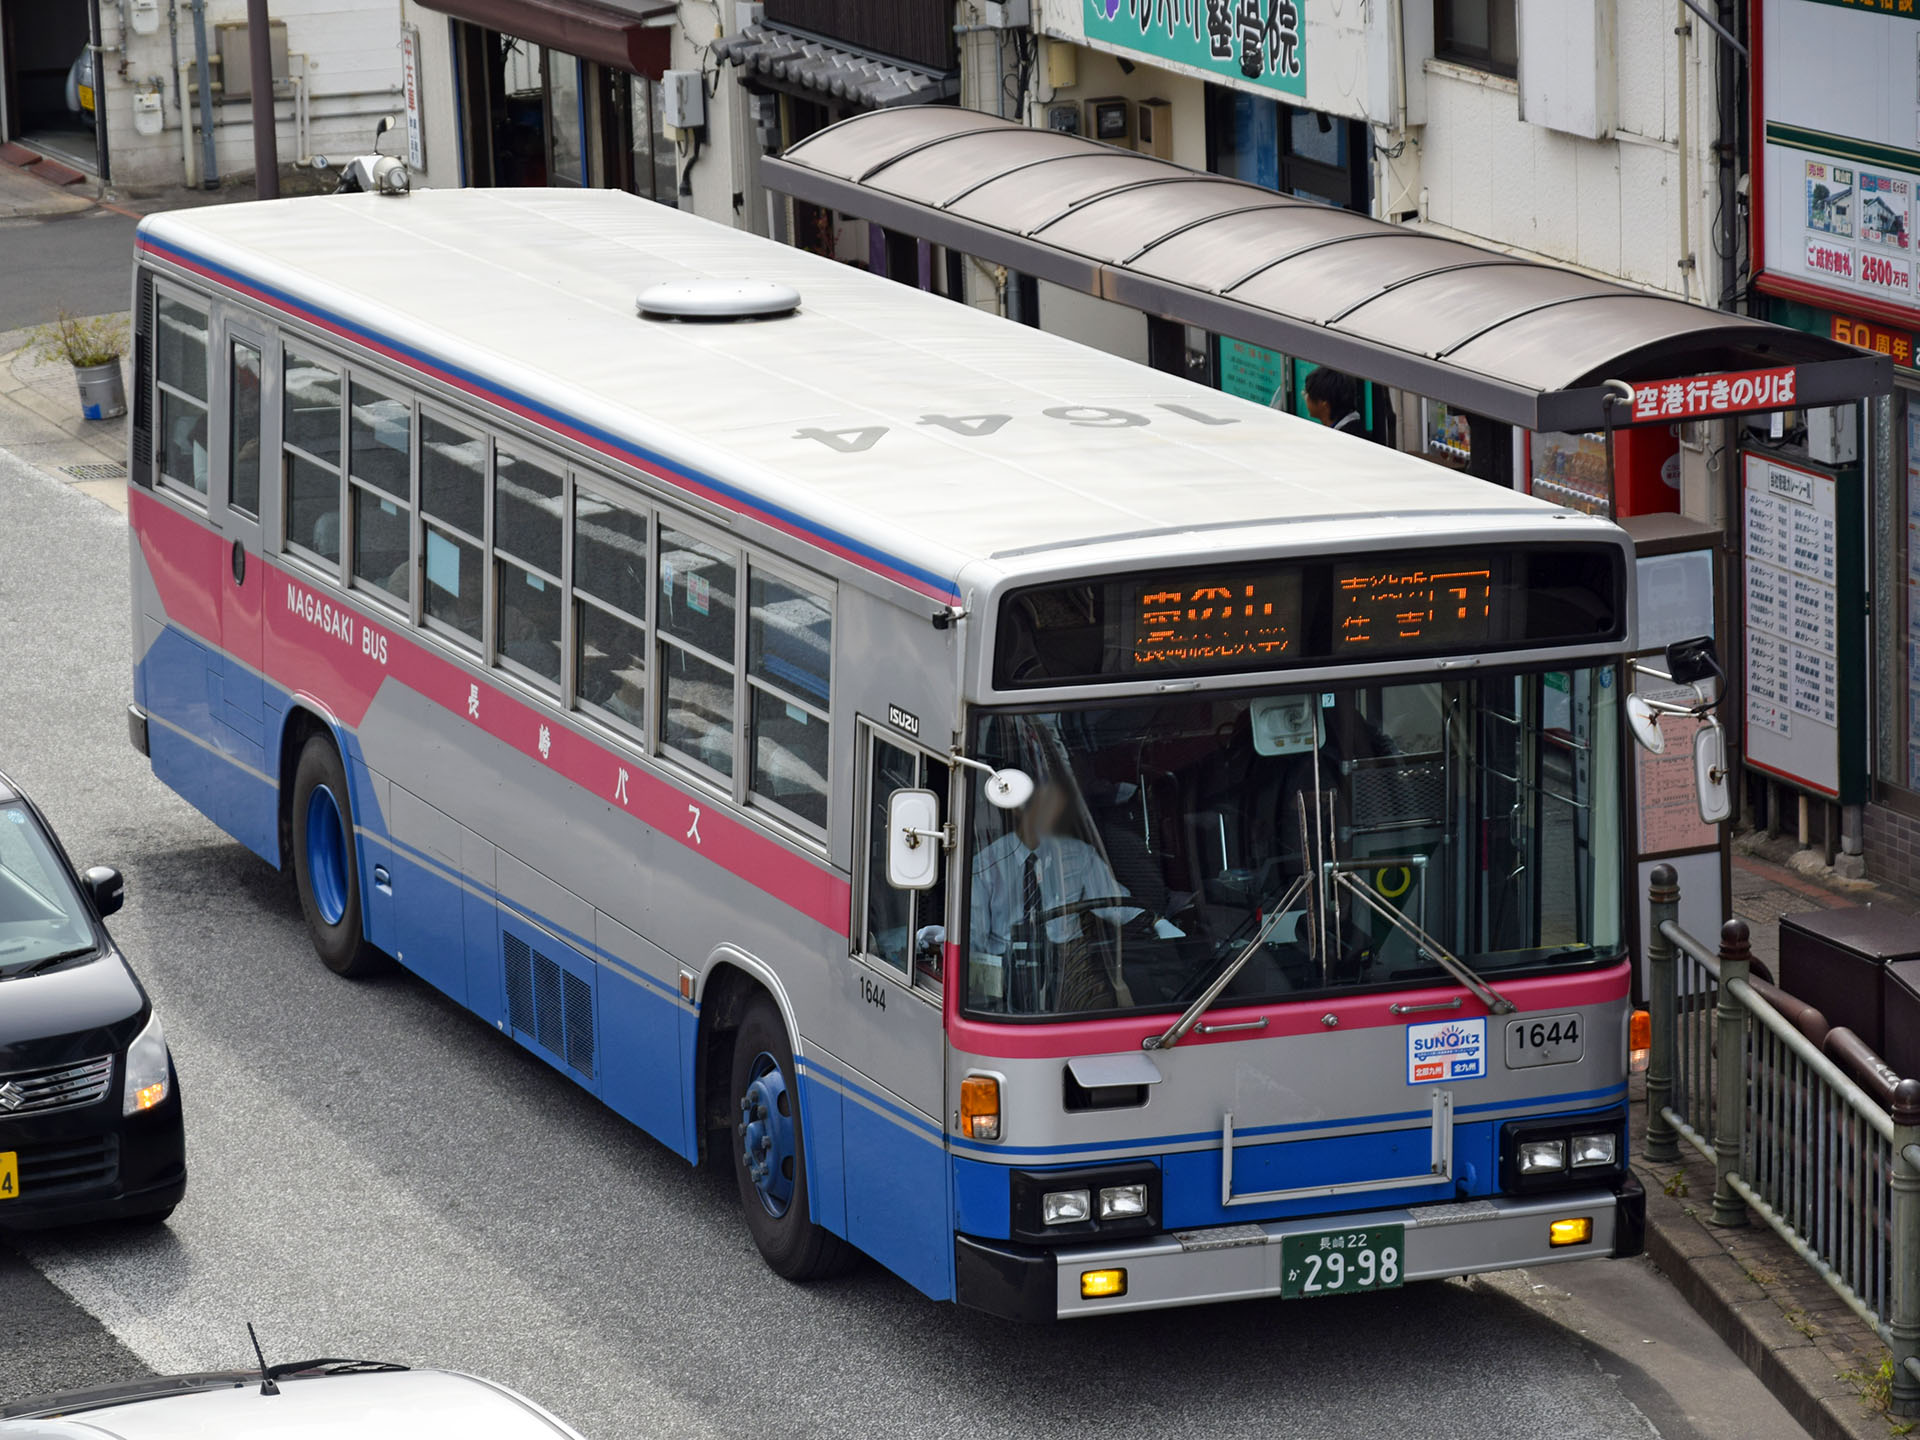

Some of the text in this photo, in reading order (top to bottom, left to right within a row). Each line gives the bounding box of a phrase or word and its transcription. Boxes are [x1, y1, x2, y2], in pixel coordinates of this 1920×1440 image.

[1835, 318, 1909, 361] 50周年
[1636, 370, 1795, 418] 空港行きのりば
[287, 582, 388, 665] NAGASAKI BUS
[890, 706, 919, 734] ISUZU
[859, 976, 887, 1012] 1644
[1514, 1019, 1580, 1049] 1644
[1288, 1268, 1301, 1281] か
[1304, 1246, 1398, 1292] 29-98
